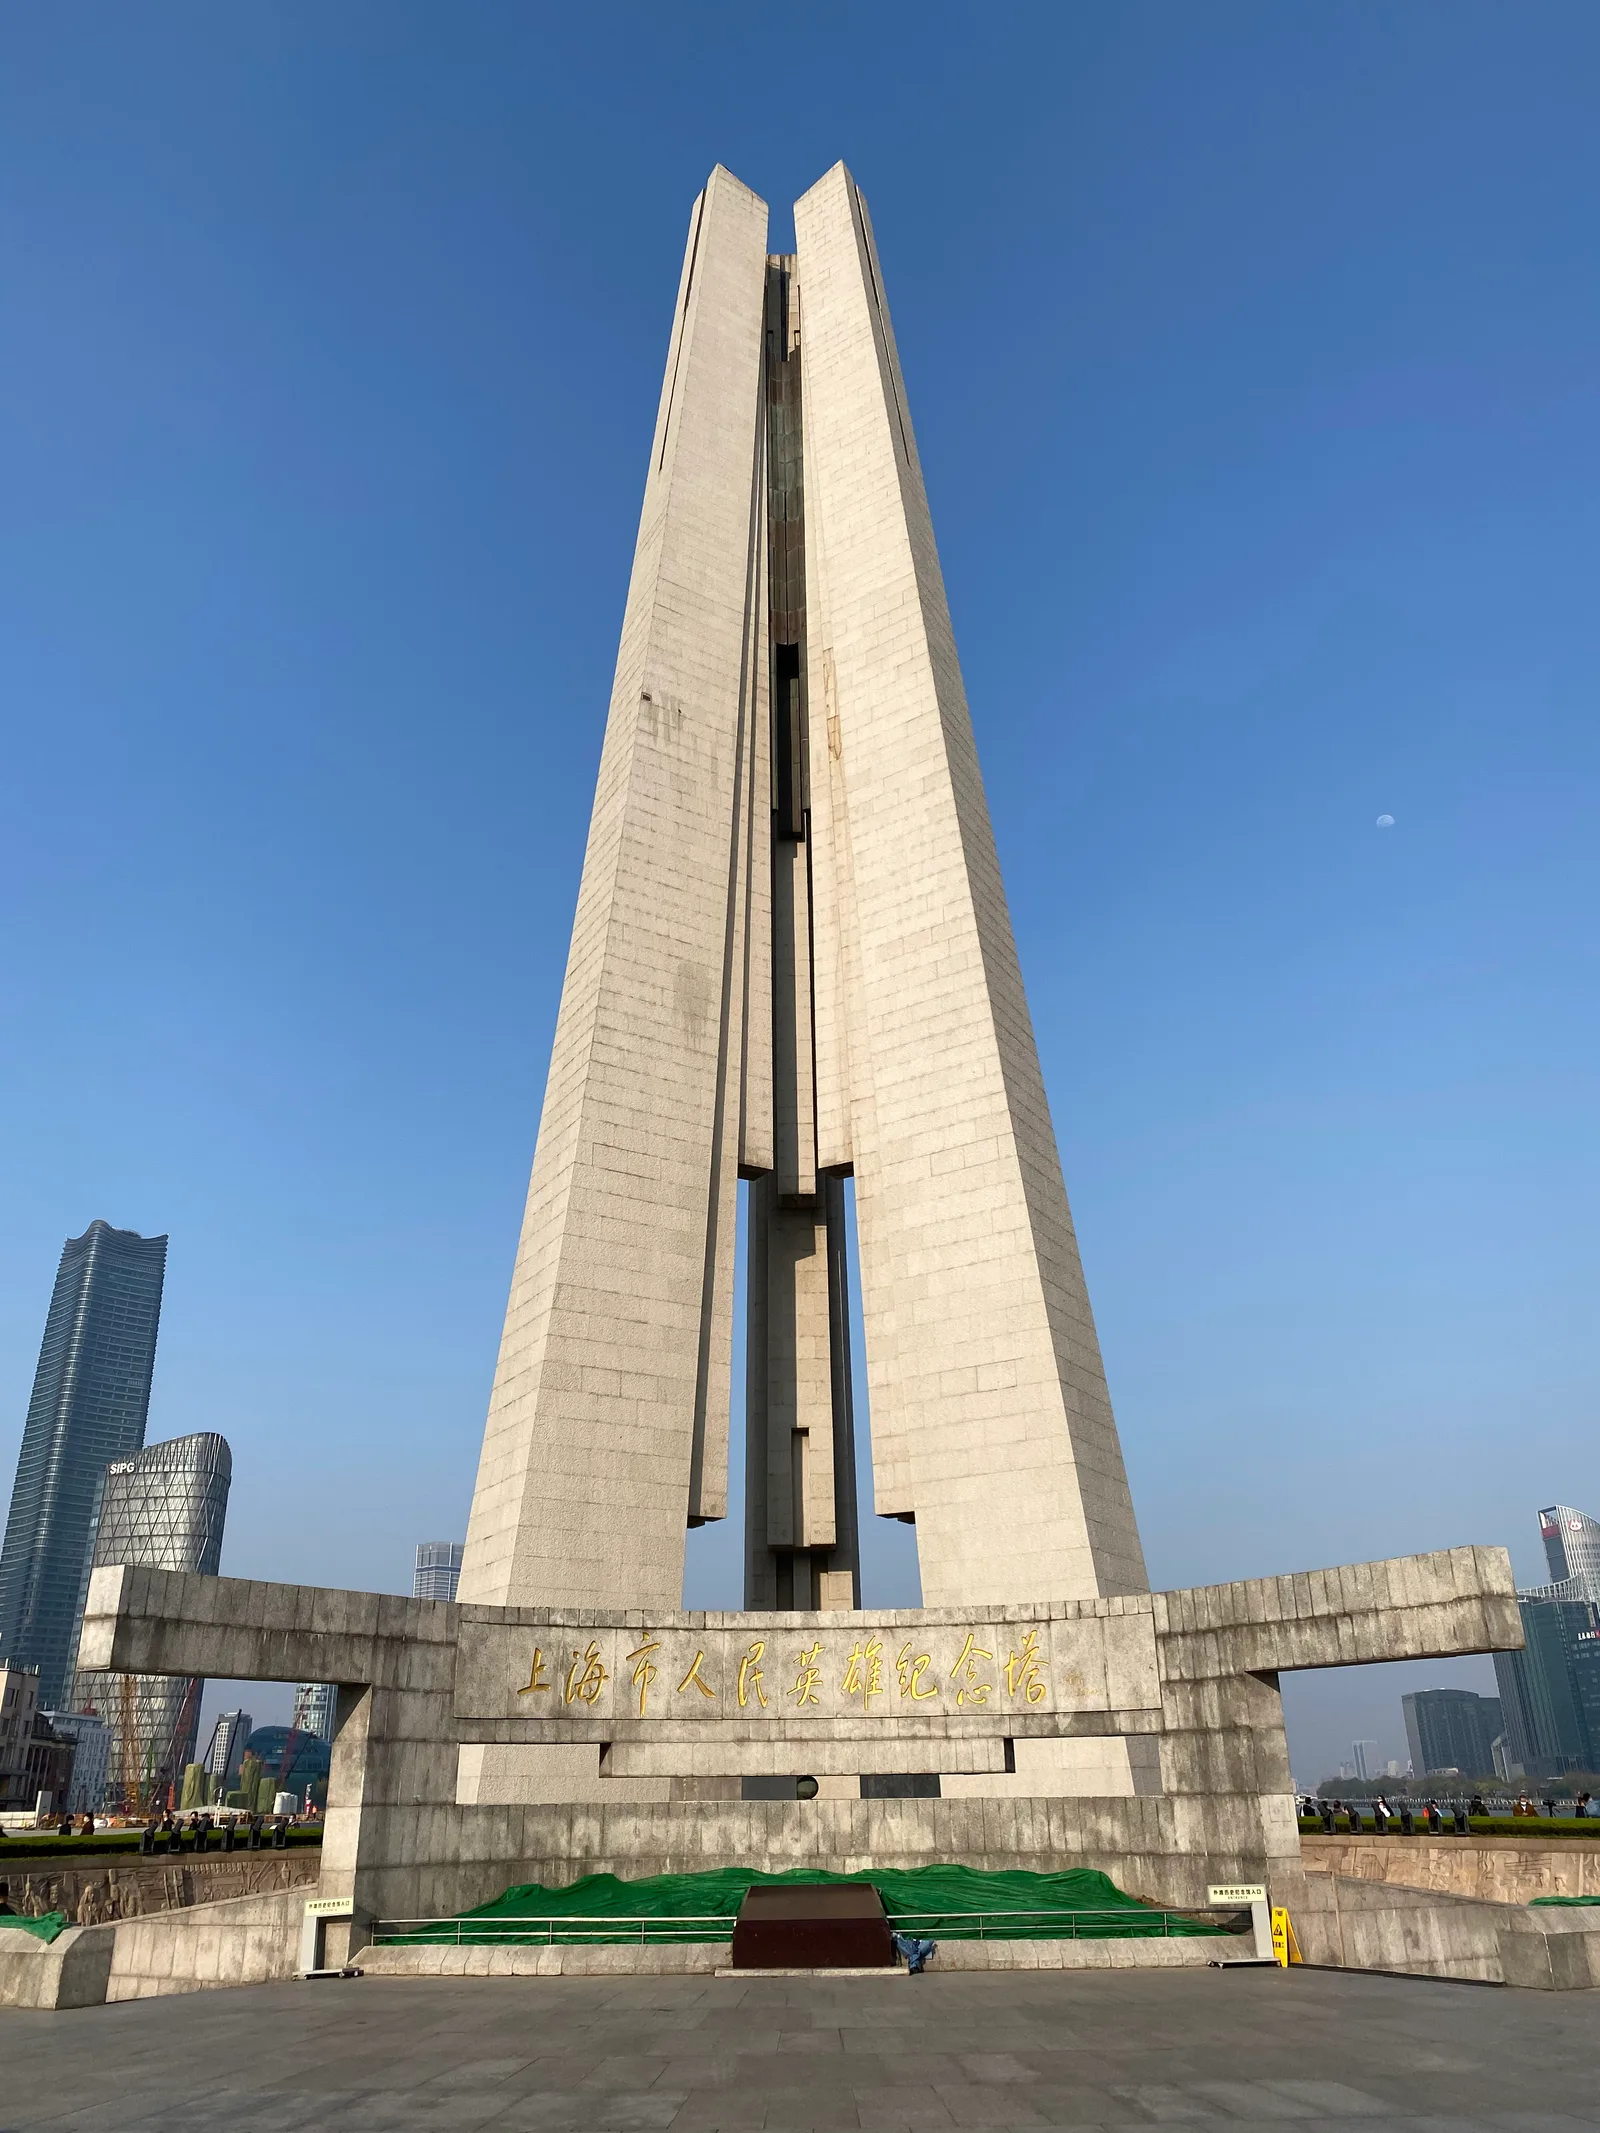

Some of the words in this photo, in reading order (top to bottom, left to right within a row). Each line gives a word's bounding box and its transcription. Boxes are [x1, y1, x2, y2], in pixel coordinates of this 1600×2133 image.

[110, 1462, 135, 1475] SIPG
[516, 1629, 1050, 1717] 上海市人民英雄纪念塔
